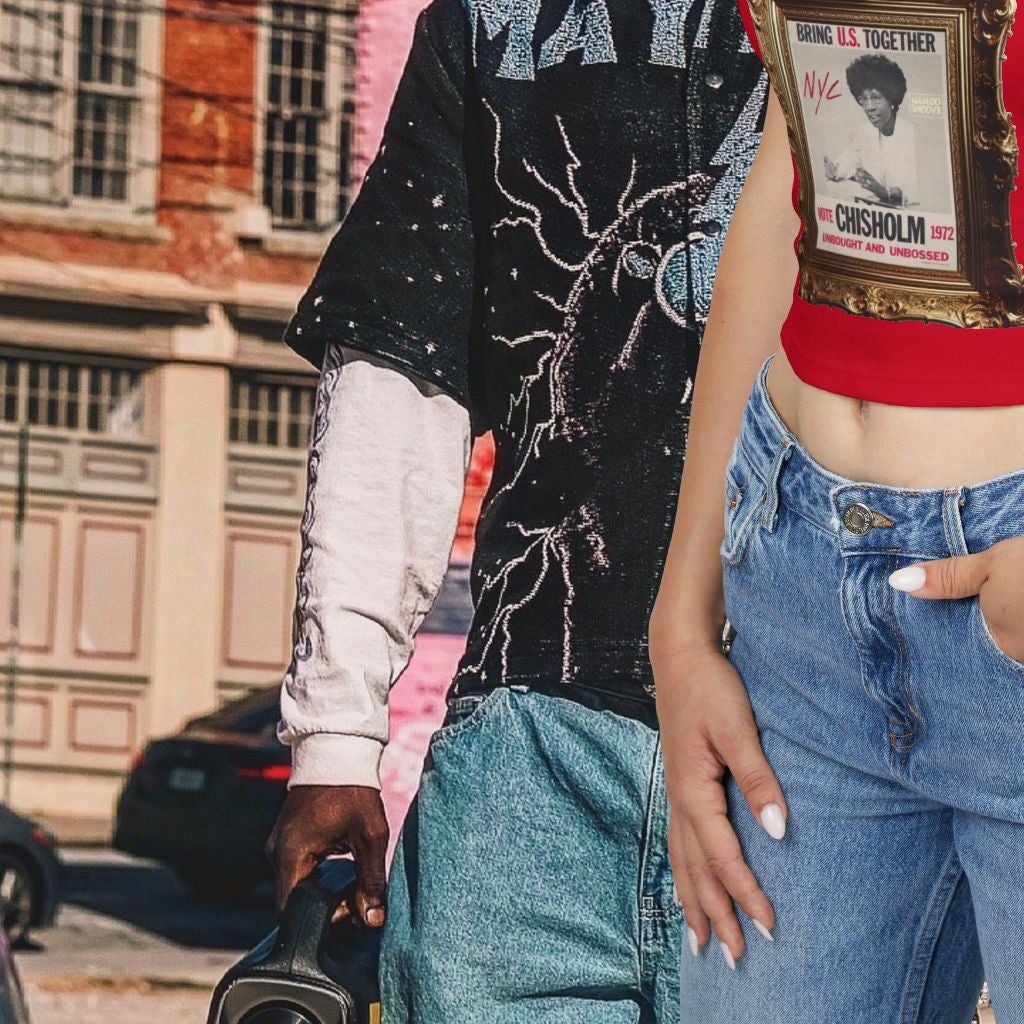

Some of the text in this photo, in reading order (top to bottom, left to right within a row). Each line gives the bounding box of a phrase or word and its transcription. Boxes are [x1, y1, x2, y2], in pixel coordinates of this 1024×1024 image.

[796, 23, 936, 52] BRING U.S. TOGETHER
[803, 70, 842, 115] NYC
[817, 203, 954, 245] VOTE CHISHOLM 1972
[822, 233, 949, 262] UNBOUGHT AND UNBOSSED
